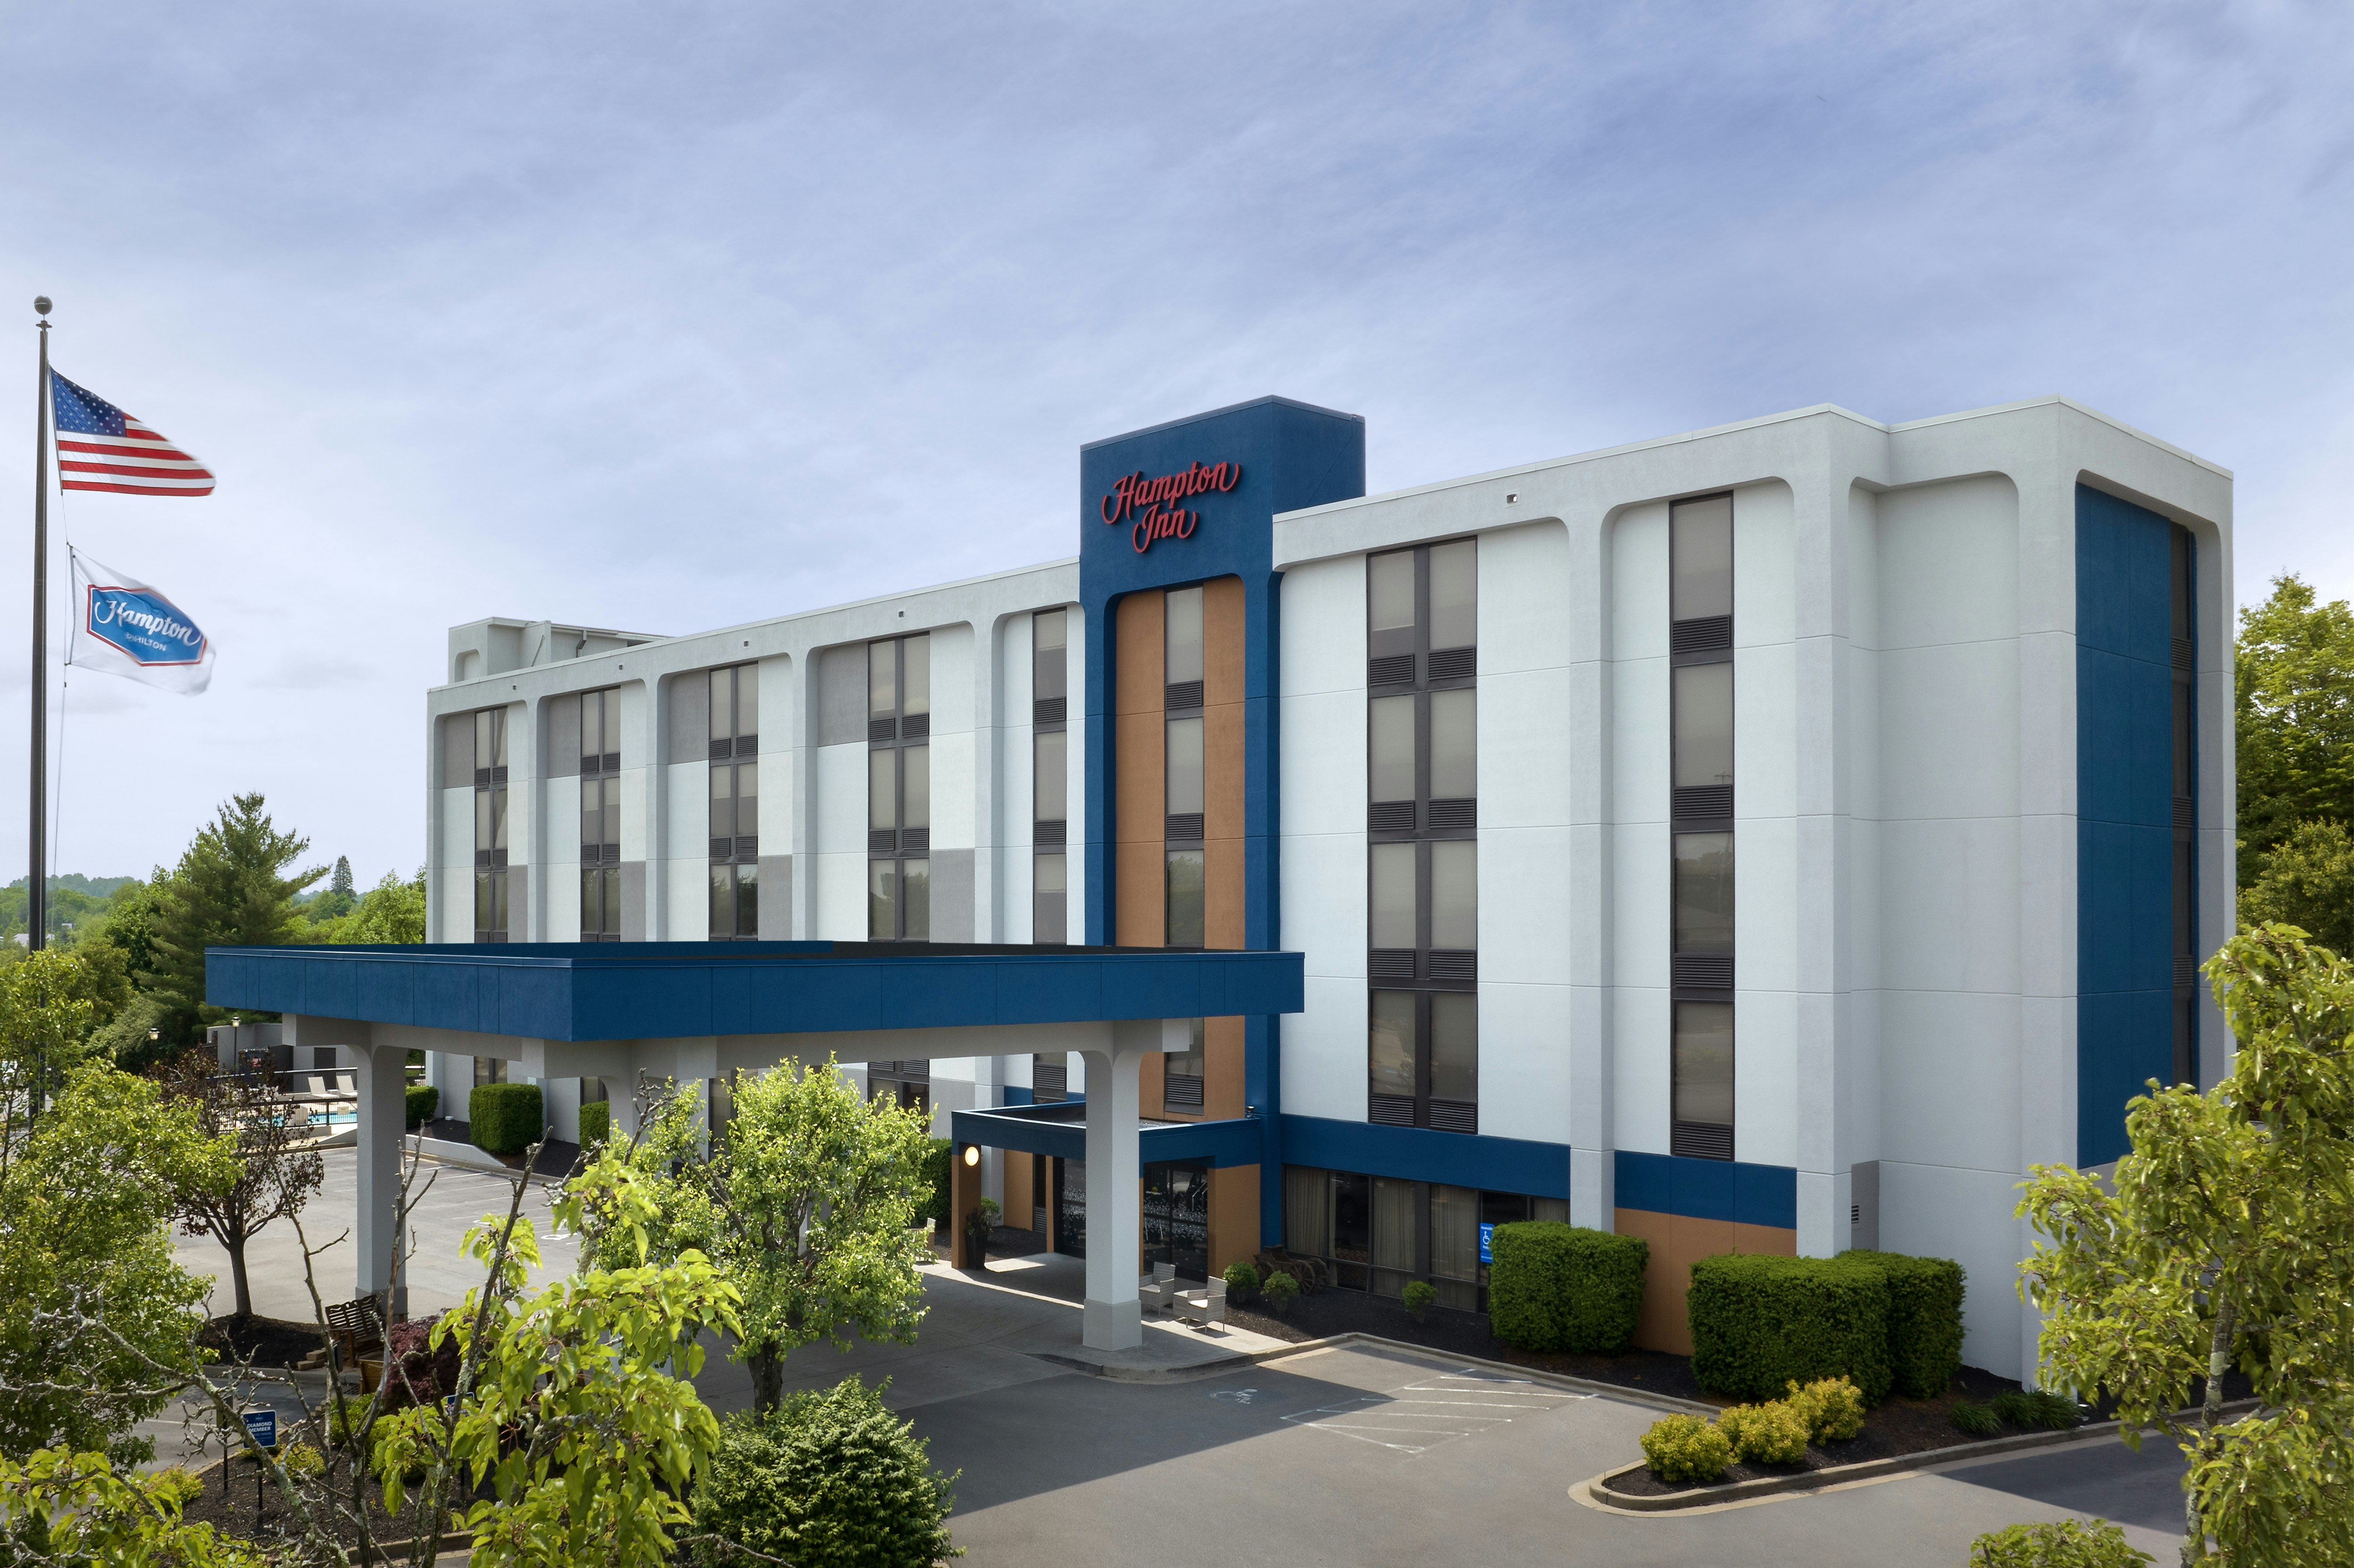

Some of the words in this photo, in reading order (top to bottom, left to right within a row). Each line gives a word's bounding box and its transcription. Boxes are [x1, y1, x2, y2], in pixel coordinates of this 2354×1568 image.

[1101, 461, 1242, 525] Hampton
[1132, 503, 1200, 554] Inn
[94, 600, 201, 646] Hampton
[134, 636, 167, 651] HILTON
